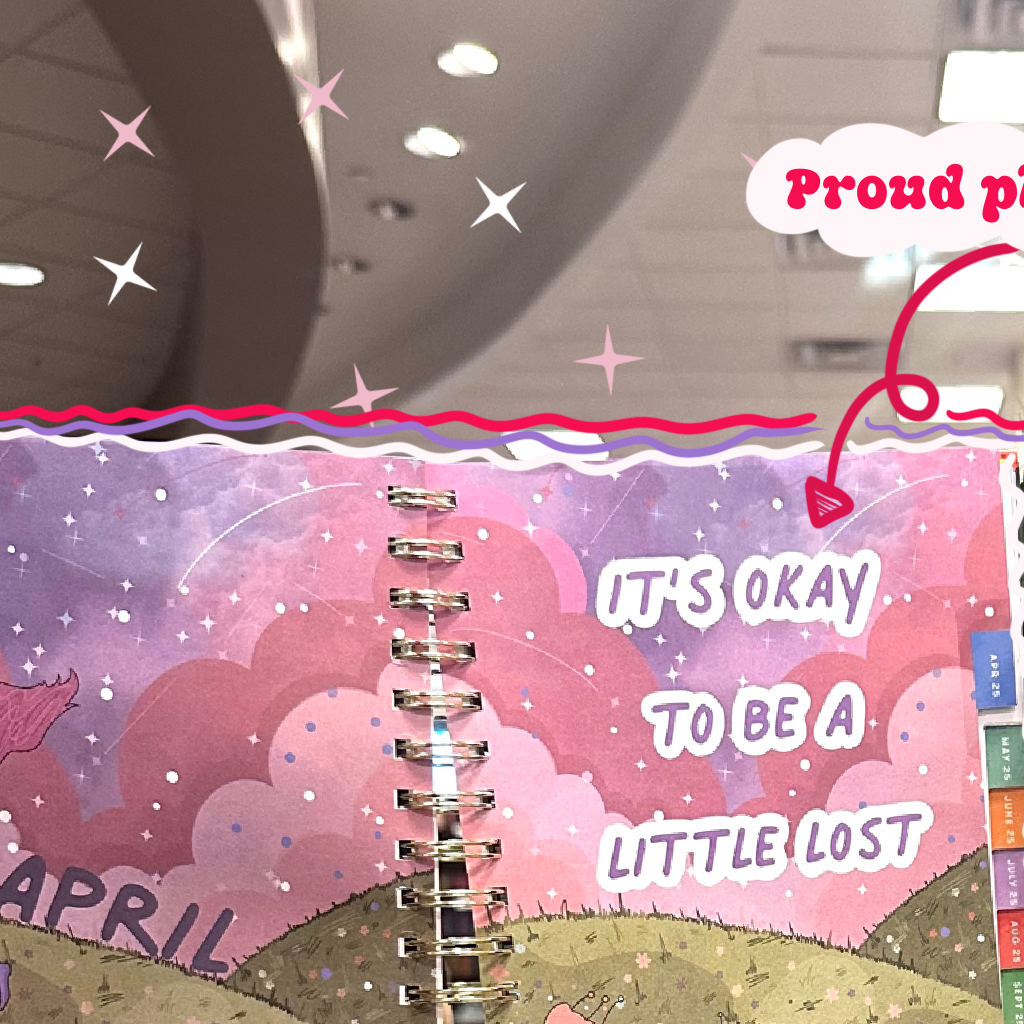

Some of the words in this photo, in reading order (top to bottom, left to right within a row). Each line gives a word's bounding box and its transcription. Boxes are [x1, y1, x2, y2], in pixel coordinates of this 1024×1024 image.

[607, 567, 714, 616] IT'S
[744, 562, 870, 625] OKAY
[989, 654, 1000, 678] APR
[991, 682, 1001, 698] 25
[651, 702, 715, 747] TO
[743, 697, 800, 742] BE
[825, 693, 854, 738] A
[1001, 737, 1011, 762] MAY
[1003, 765, 1012, 781] 25
[1004, 795, 1014, 825] JUNE
[607, 826, 780, 879] LITTLE
[805, 813, 923, 863] LOST
[1006, 829, 1015, 844] 25
[1007, 859, 1018, 887] JULY
[1009, 891, 1018, 906] 25
[0, 854, 234, 974] APRIL
[1010, 920, 1021, 946] AUG
[1012, 949, 1021, 963] 25
[1013, 981, 1023, 1009] SEPT
